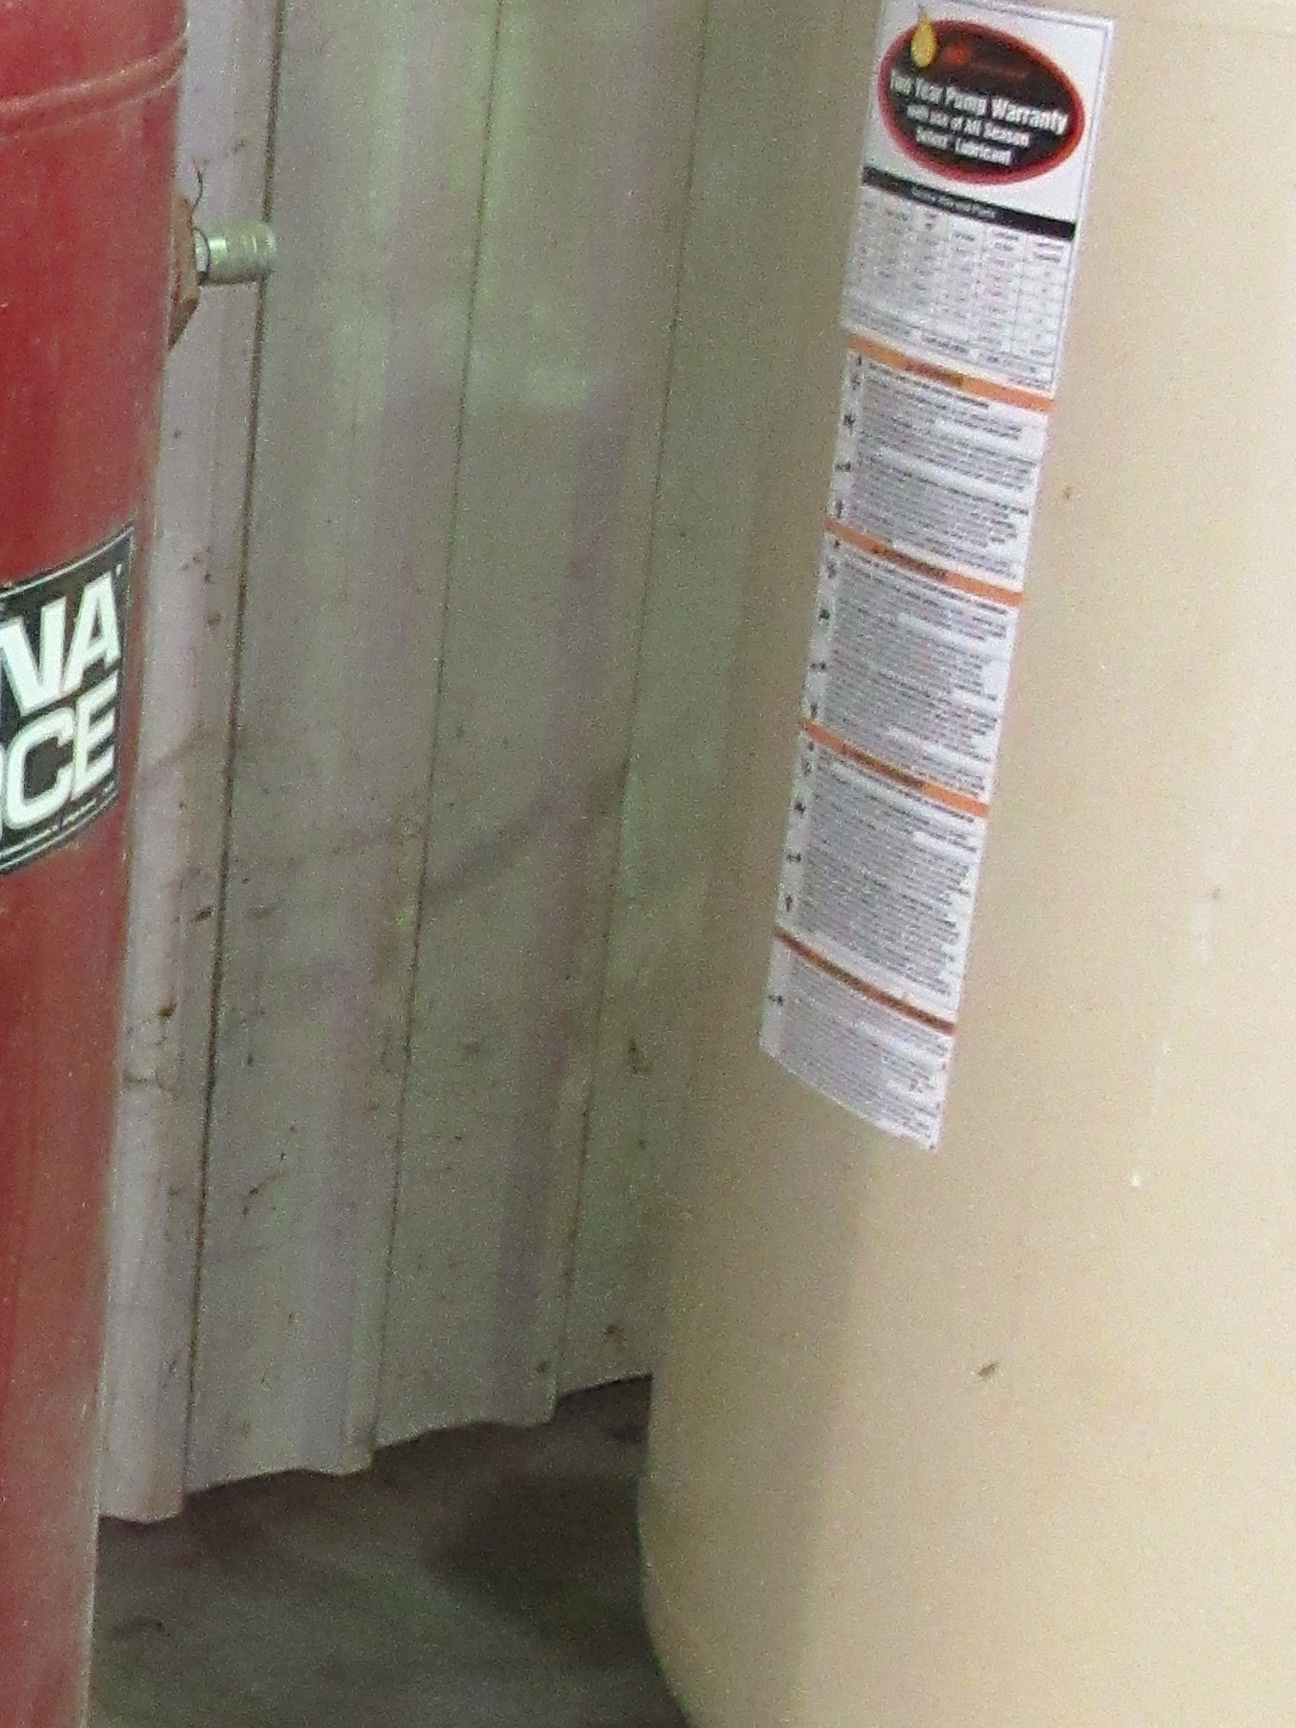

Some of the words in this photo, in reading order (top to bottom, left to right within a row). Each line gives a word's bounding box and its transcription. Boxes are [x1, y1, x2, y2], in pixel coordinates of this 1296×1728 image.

[945, 85, 987, 116] Pump
[991, 95, 1068, 136] Warranty
[983, 122, 1030, 148] Season
[955, 137, 1012, 166] Lubricant
